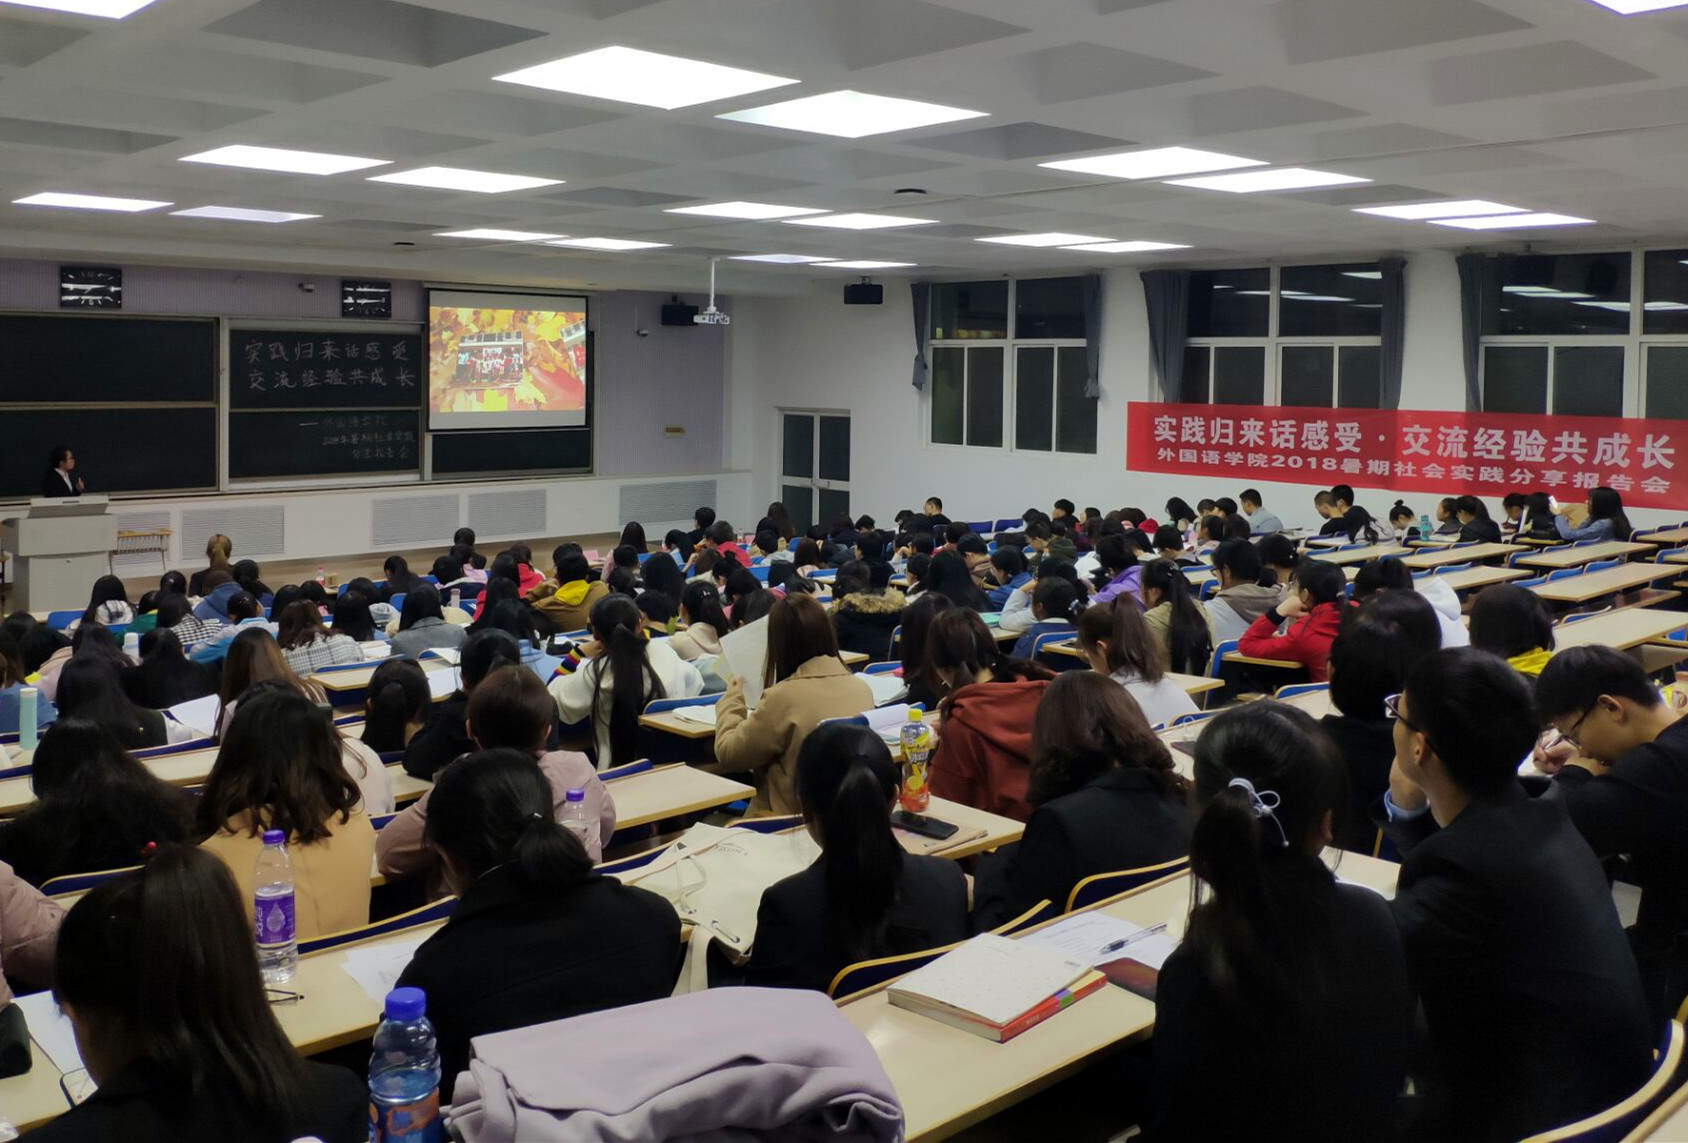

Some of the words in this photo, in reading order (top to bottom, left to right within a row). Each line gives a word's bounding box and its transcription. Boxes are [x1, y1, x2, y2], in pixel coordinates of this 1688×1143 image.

[245, 339, 409, 364] 实践归来话感受
[248, 366, 415, 391] 交流经验共成长
[1157, 447, 1671, 494] 外国语学院2018暑期社会实践分享报告会
